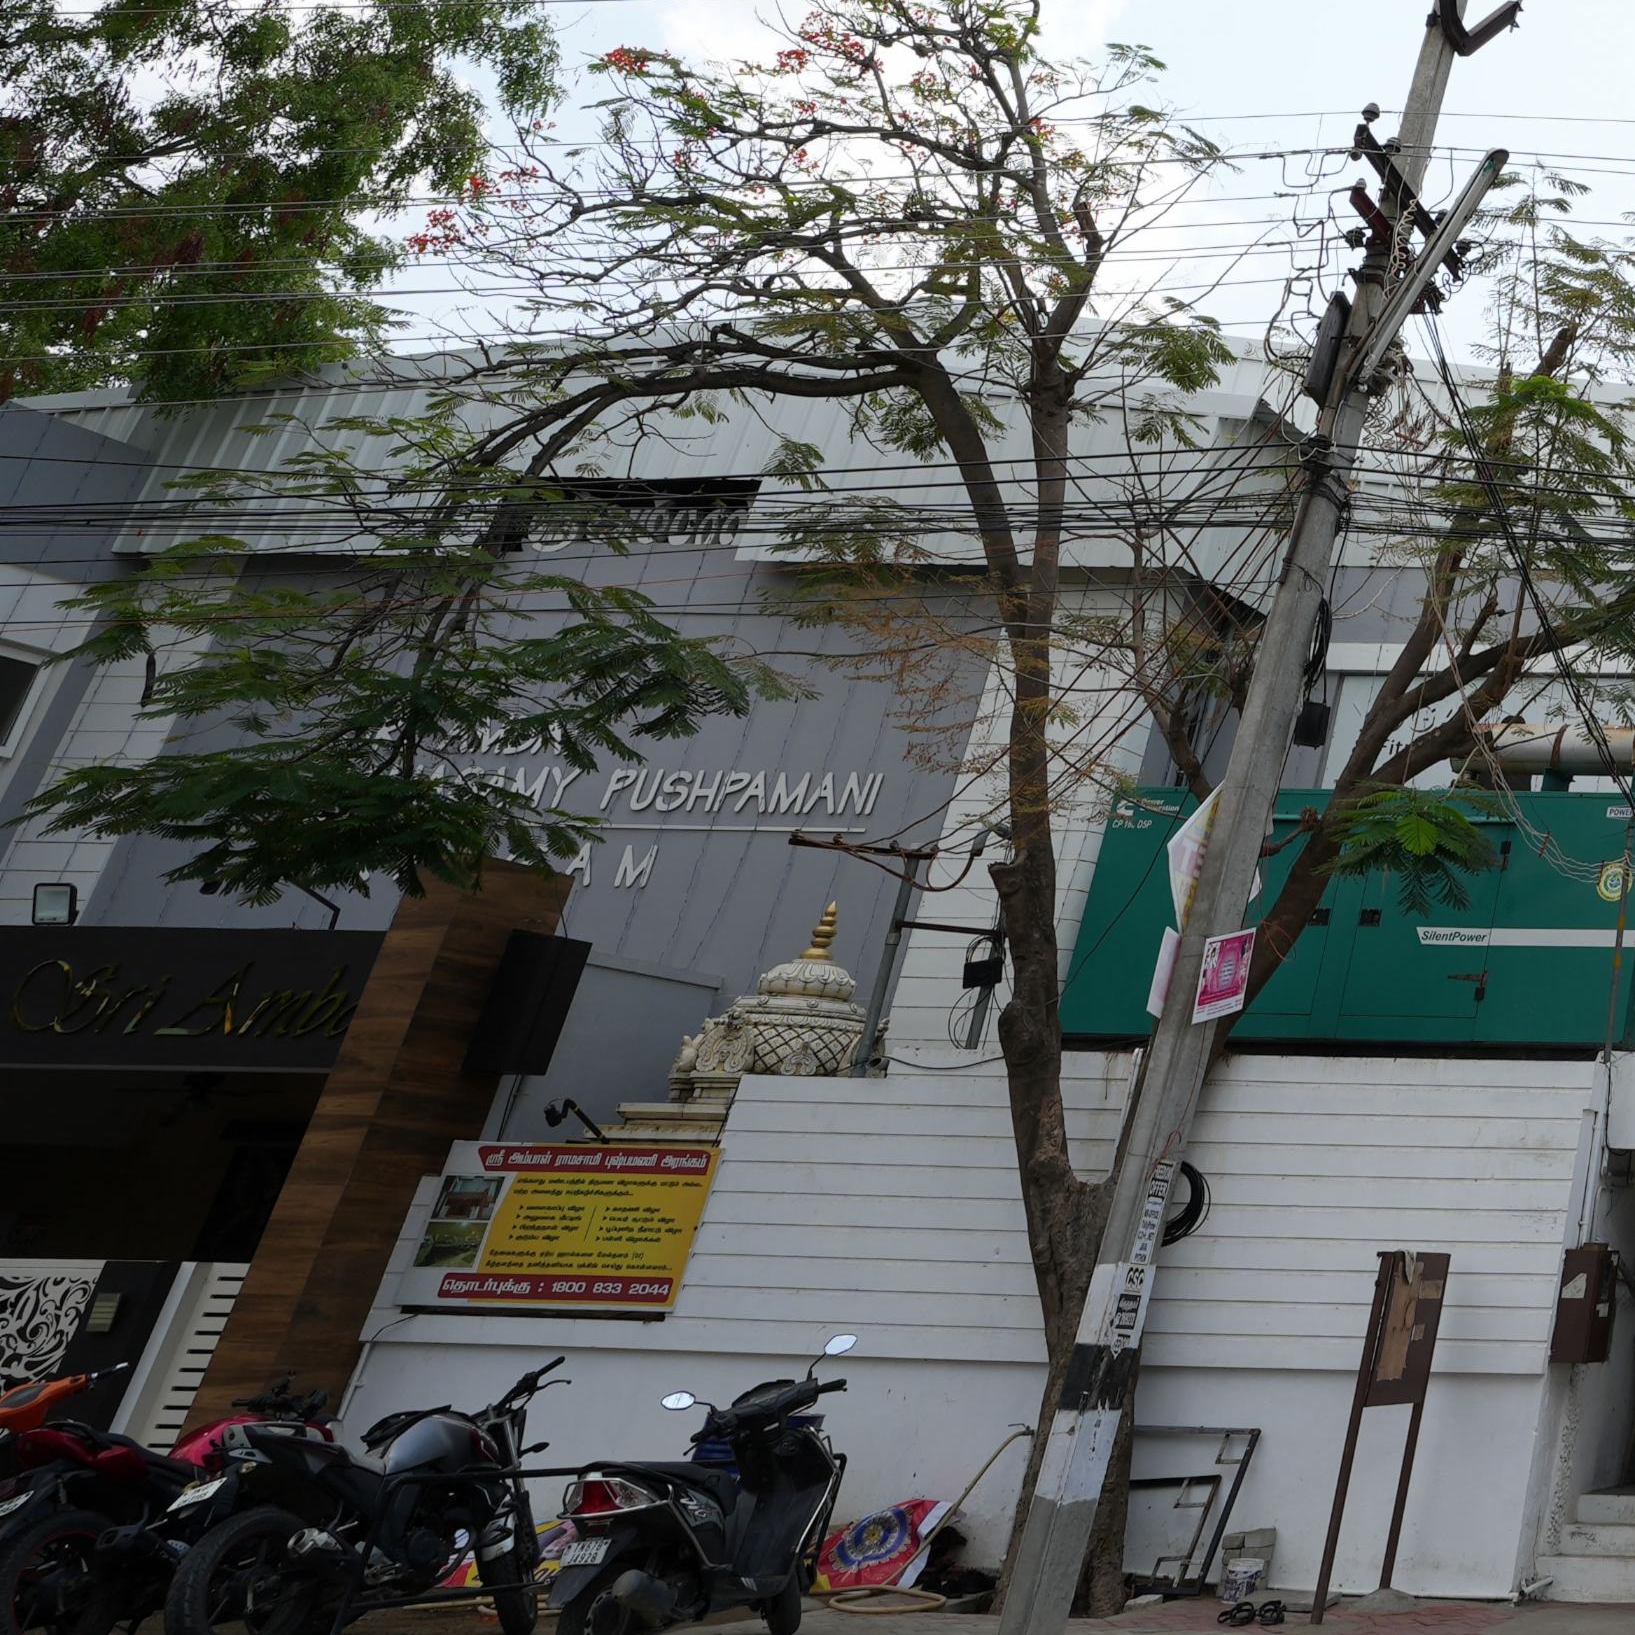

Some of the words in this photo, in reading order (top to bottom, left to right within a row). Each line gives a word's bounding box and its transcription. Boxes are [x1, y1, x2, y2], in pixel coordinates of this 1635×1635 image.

[599, 769, 884, 815] PUSHPAMANI
[1421, 931, 1487, 943] SilentPower
[13, 958, 173, 1035] Sri
[554, 1151, 602, 1167] ராமசாமி
[660, 1153, 707, 1169] அரங்கம்
[442, 1280, 530, 1295] தொடர்புக்கு
[552, 1281, 586, 1293] 1800
[592, 1282, 622, 1294] 833
[629, 1283, 669, 1295] 2044
